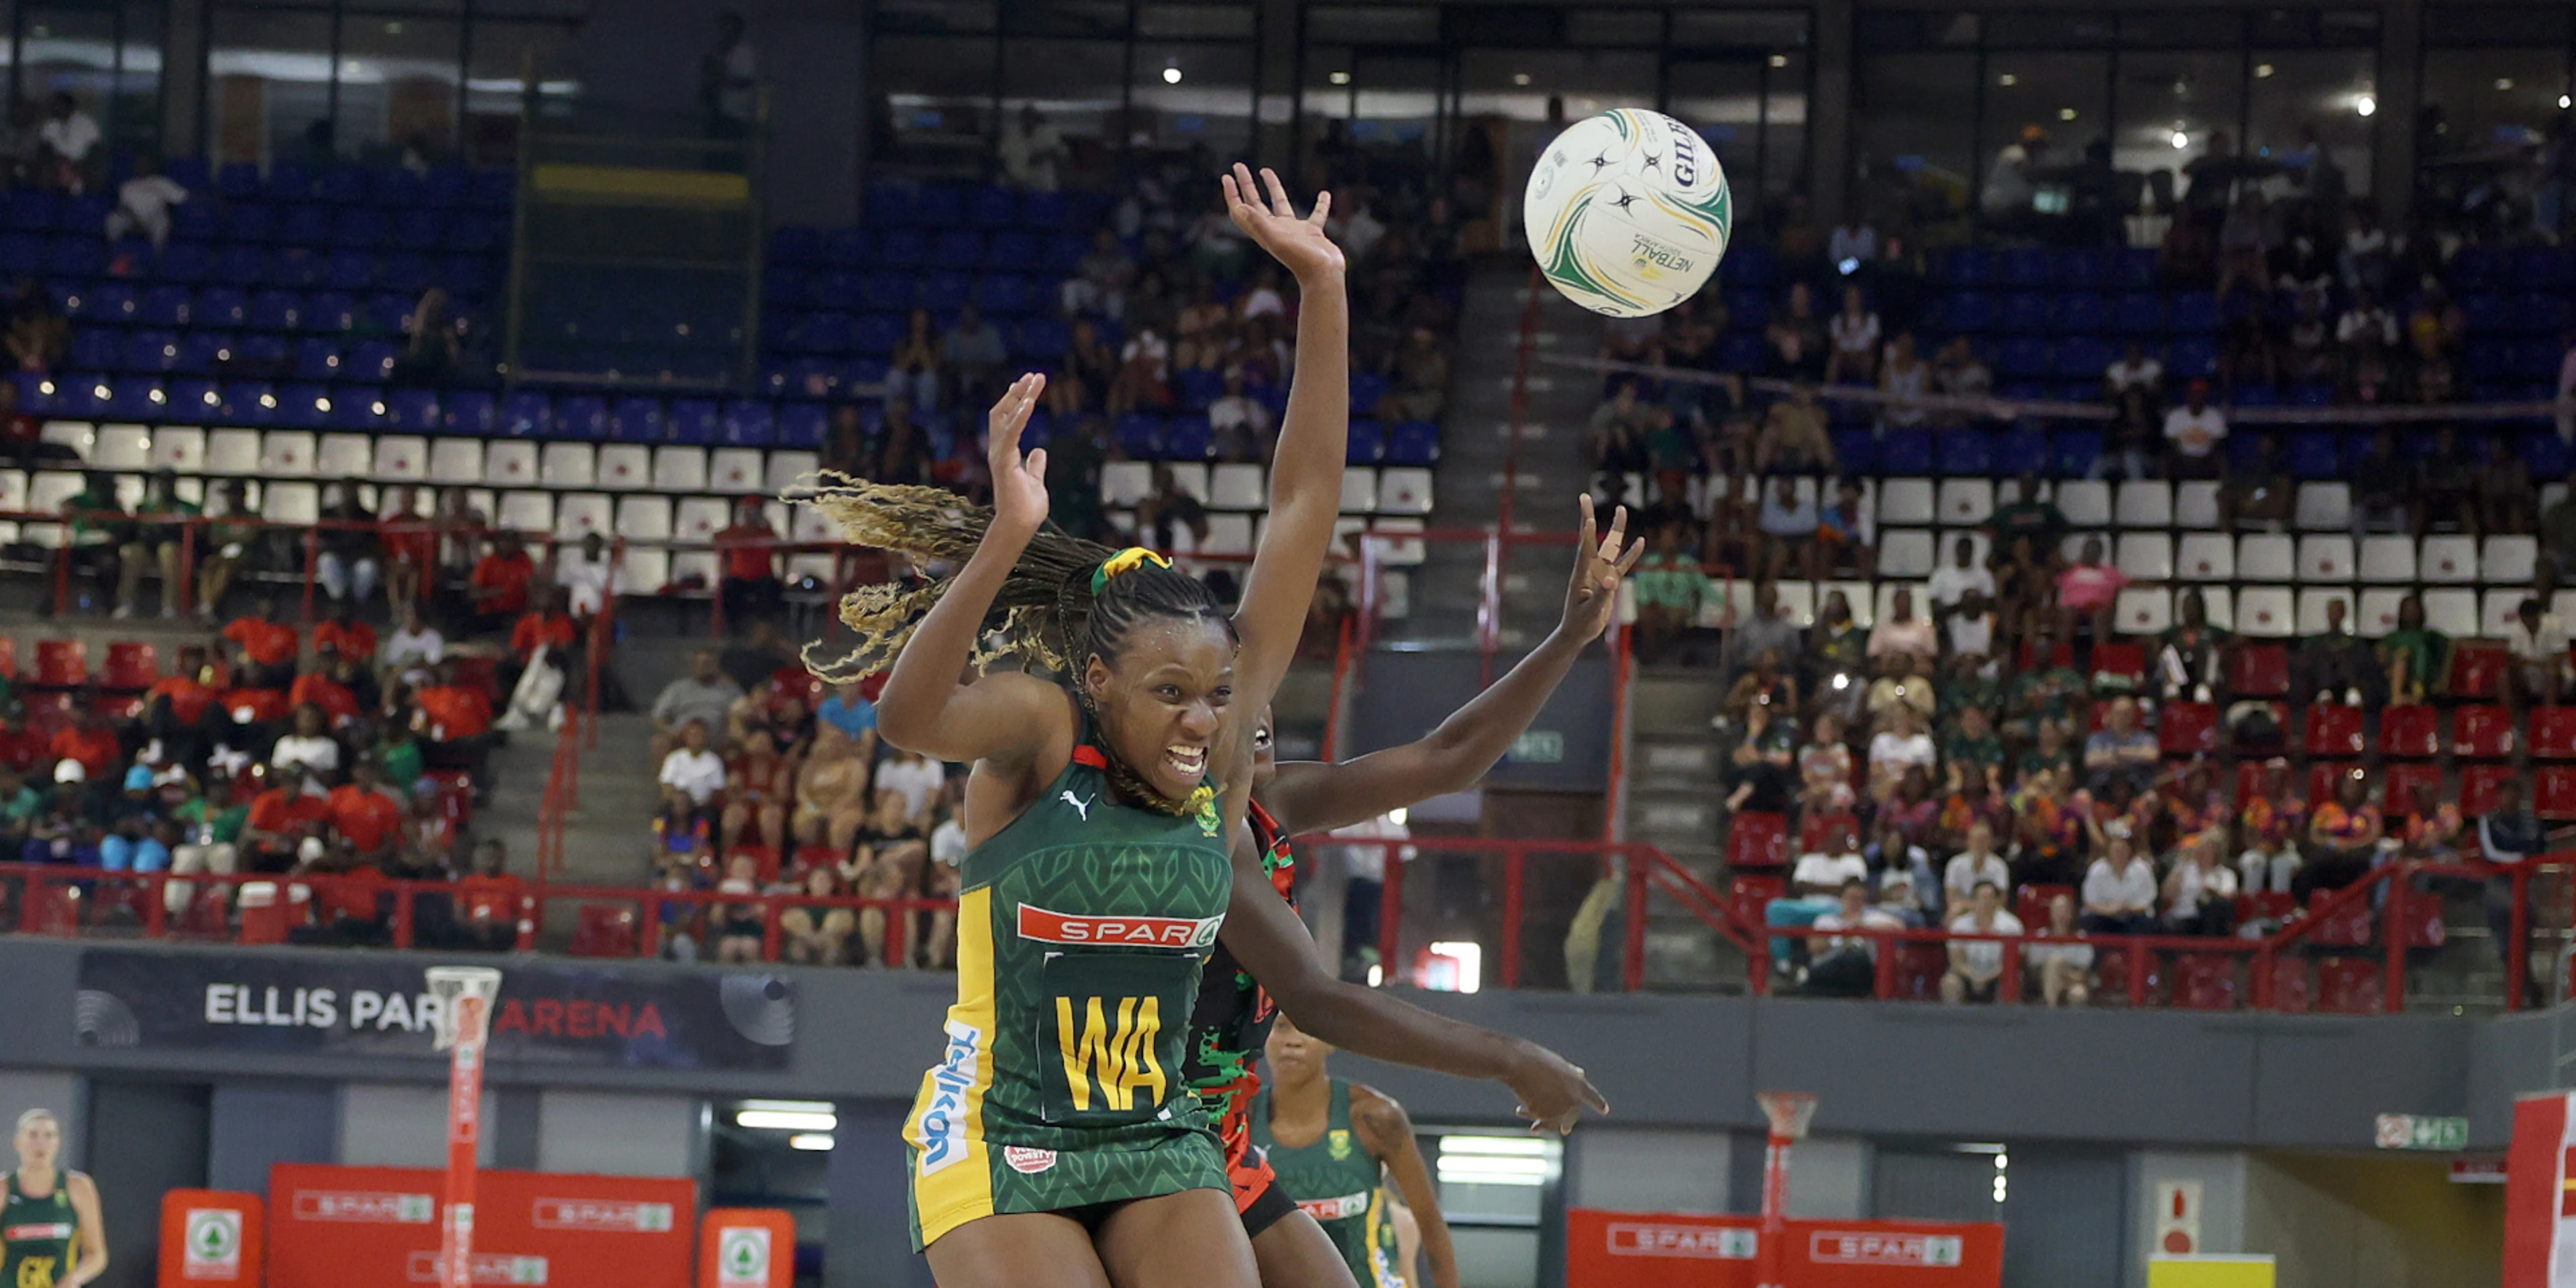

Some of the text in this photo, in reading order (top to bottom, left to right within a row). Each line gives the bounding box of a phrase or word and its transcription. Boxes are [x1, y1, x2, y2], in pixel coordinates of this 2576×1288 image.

[1631, 239, 1695, 273] NETBALL
[1060, 922, 1192, 943] SPAR
[205, 984, 667, 1038] ELLIS PAR ARENA
[1055, 996, 1167, 1111] WA
[319, 1197, 398, 1216] SPAR
[559, 1204, 638, 1224] SPAR
[1636, 1228, 1721, 1250] SPAR
[1841, 1236, 1925, 1258] SPAR
